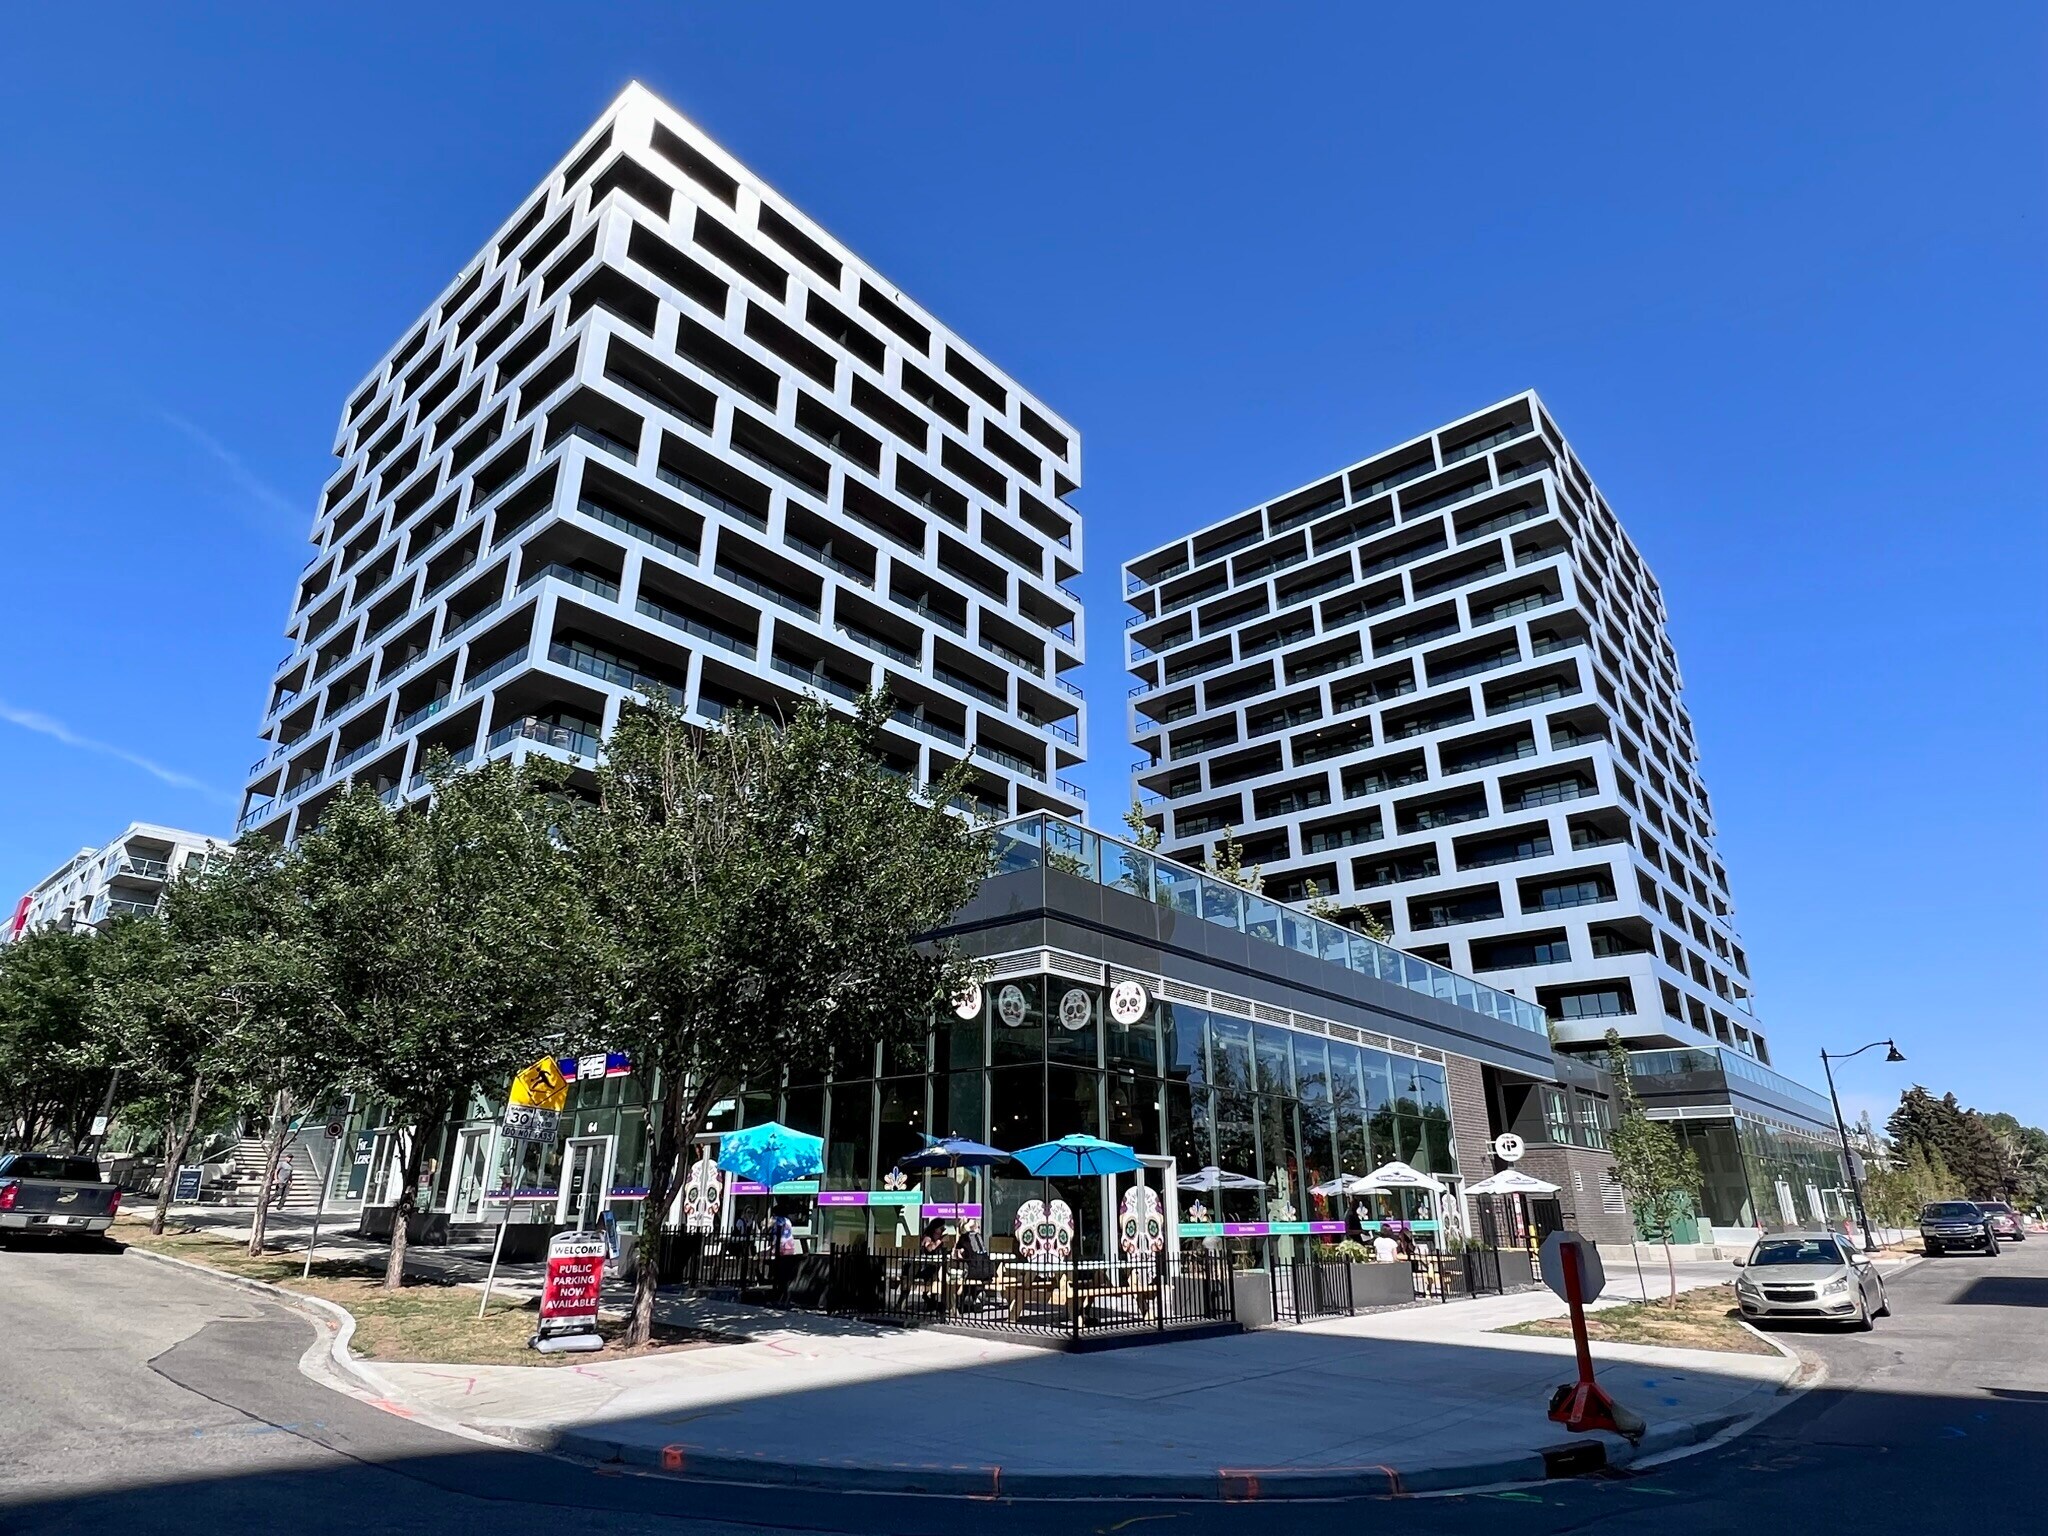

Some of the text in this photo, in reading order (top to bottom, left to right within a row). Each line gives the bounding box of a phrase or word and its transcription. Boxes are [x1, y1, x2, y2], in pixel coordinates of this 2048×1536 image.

[510, 1112, 530, 1125] 30
[505, 1127, 553, 1141] DO NOT PASS
[356, 1138, 369, 1151] For
[554, 1245, 603, 1255] WELCOME
[559, 1264, 593, 1274] PUBLIC
[553, 1275, 596, 1286] PARKING
[560, 1287, 586, 1297] NOW
[545, 1298, 597, 1310] AVAILABLE
